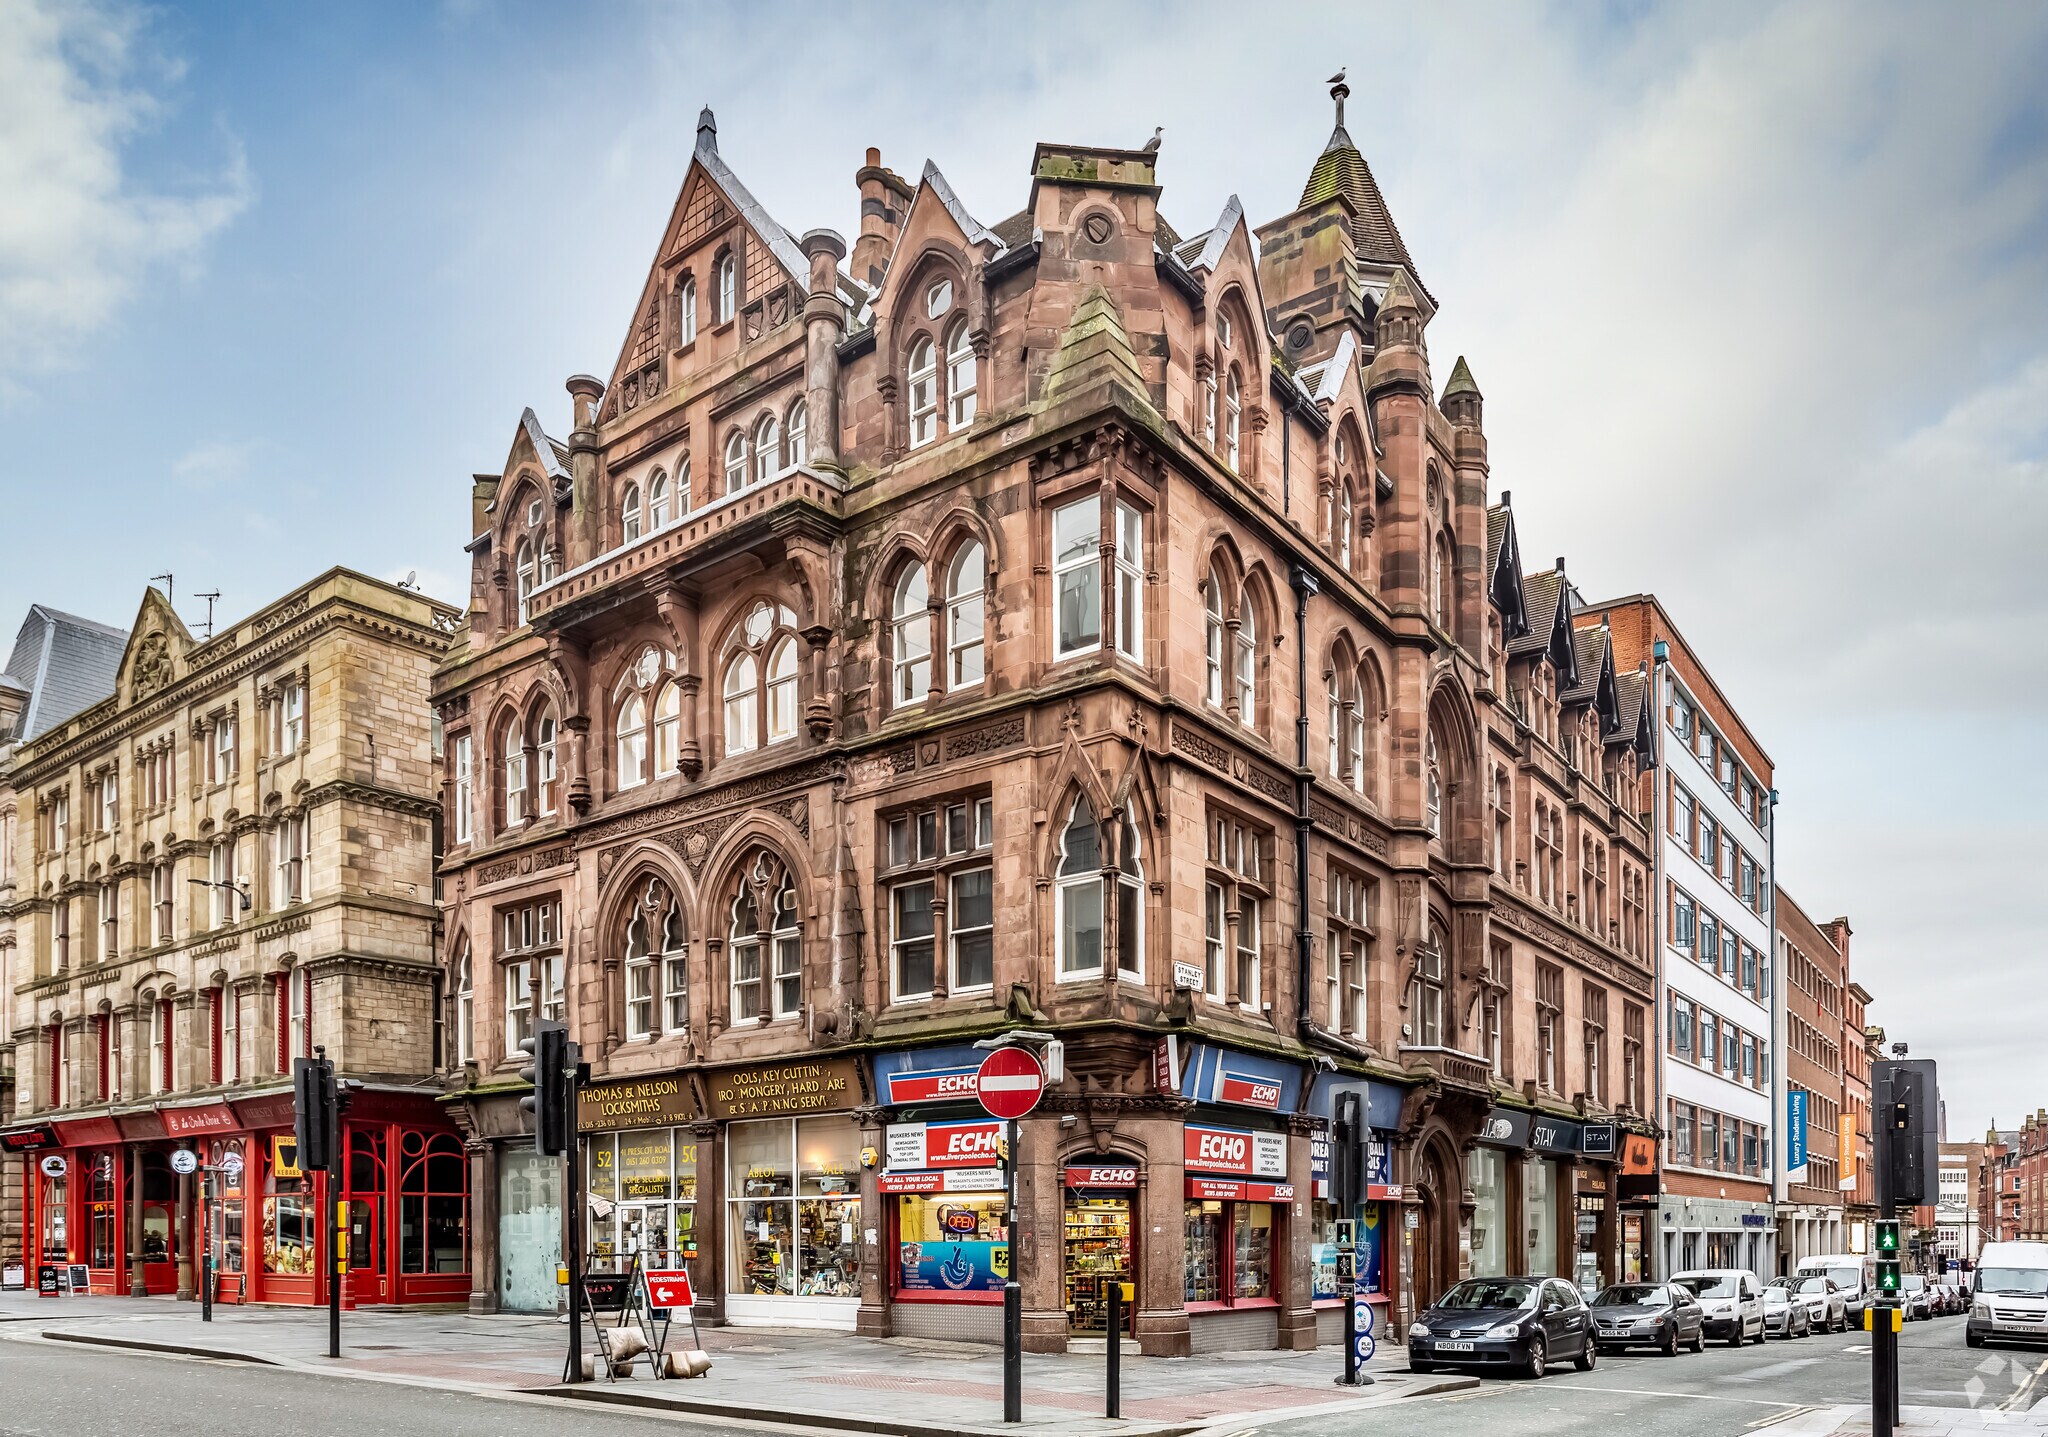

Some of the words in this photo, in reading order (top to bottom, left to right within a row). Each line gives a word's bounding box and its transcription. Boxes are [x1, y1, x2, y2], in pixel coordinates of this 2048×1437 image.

[1178, 966, 1201, 979] STANLEY
[1180, 976, 1199, 987] STREET
[1159, 1044, 1167, 1054] SOFT
[730, 1072, 762, 1086] OOLS,
[763, 1070, 780, 1082] KEY
[783, 1065, 831, 1080] CUTTIN,
[1160, 1067, 1168, 1076] SOLD
[938, 1075, 978, 1092] ECHO
[580, 1086, 623, 1103] THOMAS
[625, 1088, 634, 1098] &
[637, 1080, 678, 1098] NELSON
[718, 1084, 790, 1101] IROMONGERY,
[792, 1078, 846, 1094] HARDARE
[1252, 1086, 1276, 1100] ECHO
[601, 1098, 660, 1116] LOCKSMITHS
[730, 1105, 738, 1114] &
[1792, 1095, 1801, 1115] Living
[1792, 1116, 1800, 1141] Student
[1534, 1126, 1556, 1146] STAY
[1586, 1134, 1610, 1142] STAY
[627, 1146, 653, 1156] PRESCOT
[1200, 1134, 1246, 1160] ECHO
[1368, 1142, 1385, 1156] BALL
[1793, 1142, 1801, 1164] Luxury
[597, 1151, 612, 1168] 52
[626, 1158, 638, 1166] 0151
[652, 1156, 666, 1164] 0309
[1184, 1158, 1246, 1170] www.liverpoolecho.co.uk
[748, 1167, 776, 1178] ABLOY
[822, 1164, 844, 1175] YALE
[622, 1176, 640, 1184] HOME
[1090, 1170, 1136, 1181] ECHO
[628, 1184, 664, 1194] SPECIALISTS
[1274, 1186, 1294, 1197] ECHO
[1388, 1186, 1402, 1196] ECHO
[948, 1216, 975, 1228] OPEN
[649, 1275, 686, 1283] PEDESTRIANS
[1438, 1342, 1456, 1350] NB08
